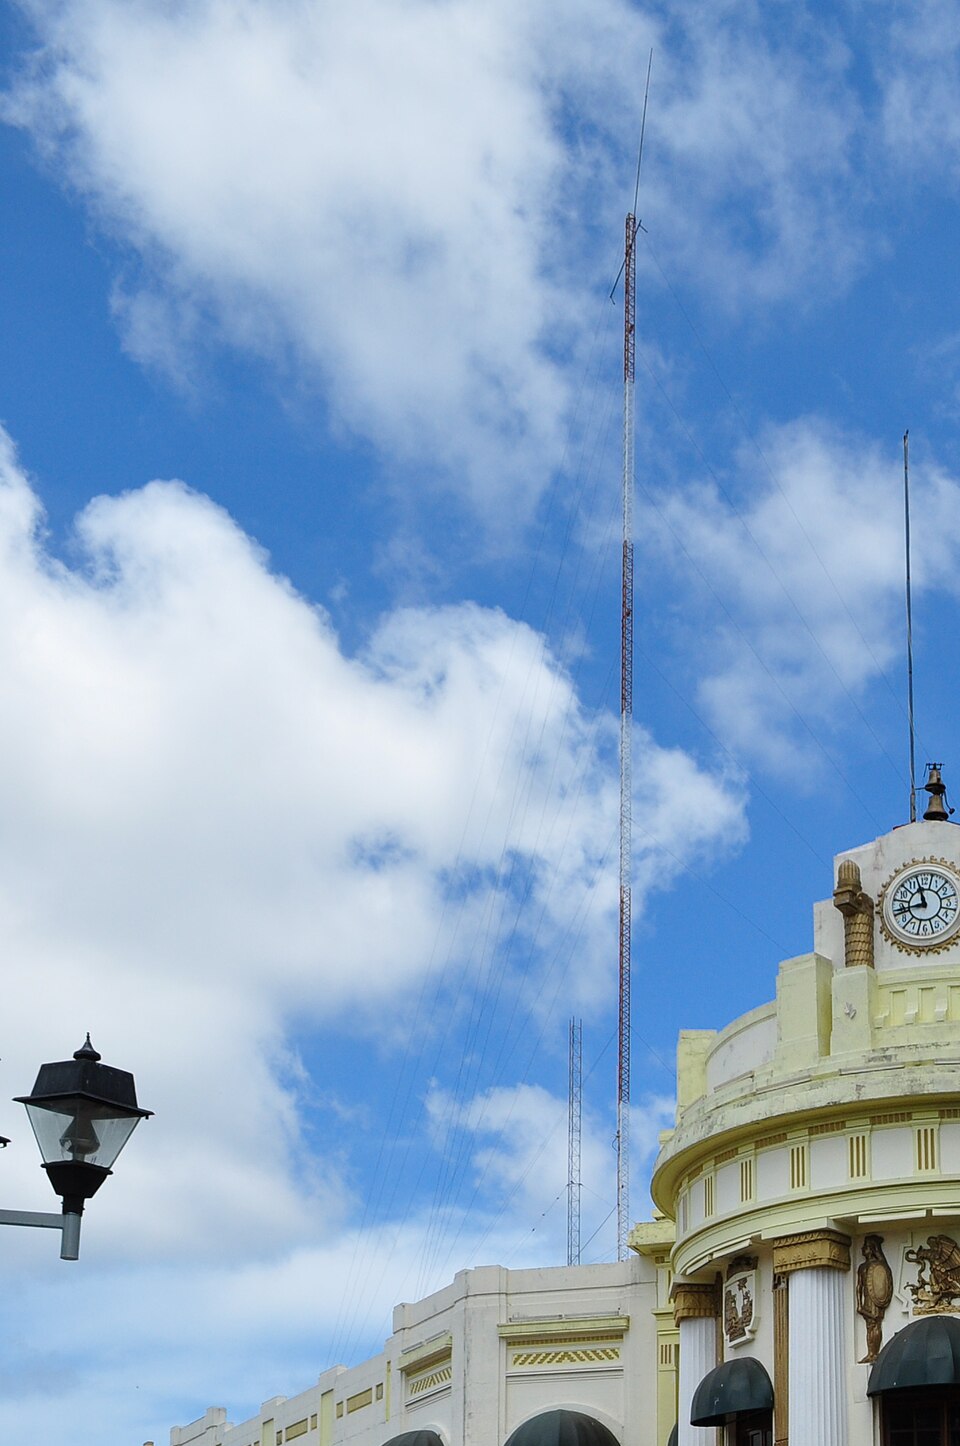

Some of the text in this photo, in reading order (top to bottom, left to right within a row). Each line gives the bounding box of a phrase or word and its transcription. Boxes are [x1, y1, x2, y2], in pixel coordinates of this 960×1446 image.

[909, 881, 916, 889] 11
[921, 877, 928, 886] 12
[900, 891, 908, 899] 10
[942, 887, 948, 896] 2
[946, 899, 951, 907] 3
[902, 914, 907, 922] 8
[942, 910, 948, 918] 4
[910, 921, 915, 930] 7
[923, 924, 928, 932] 6
[934, 921, 940, 929] 5
